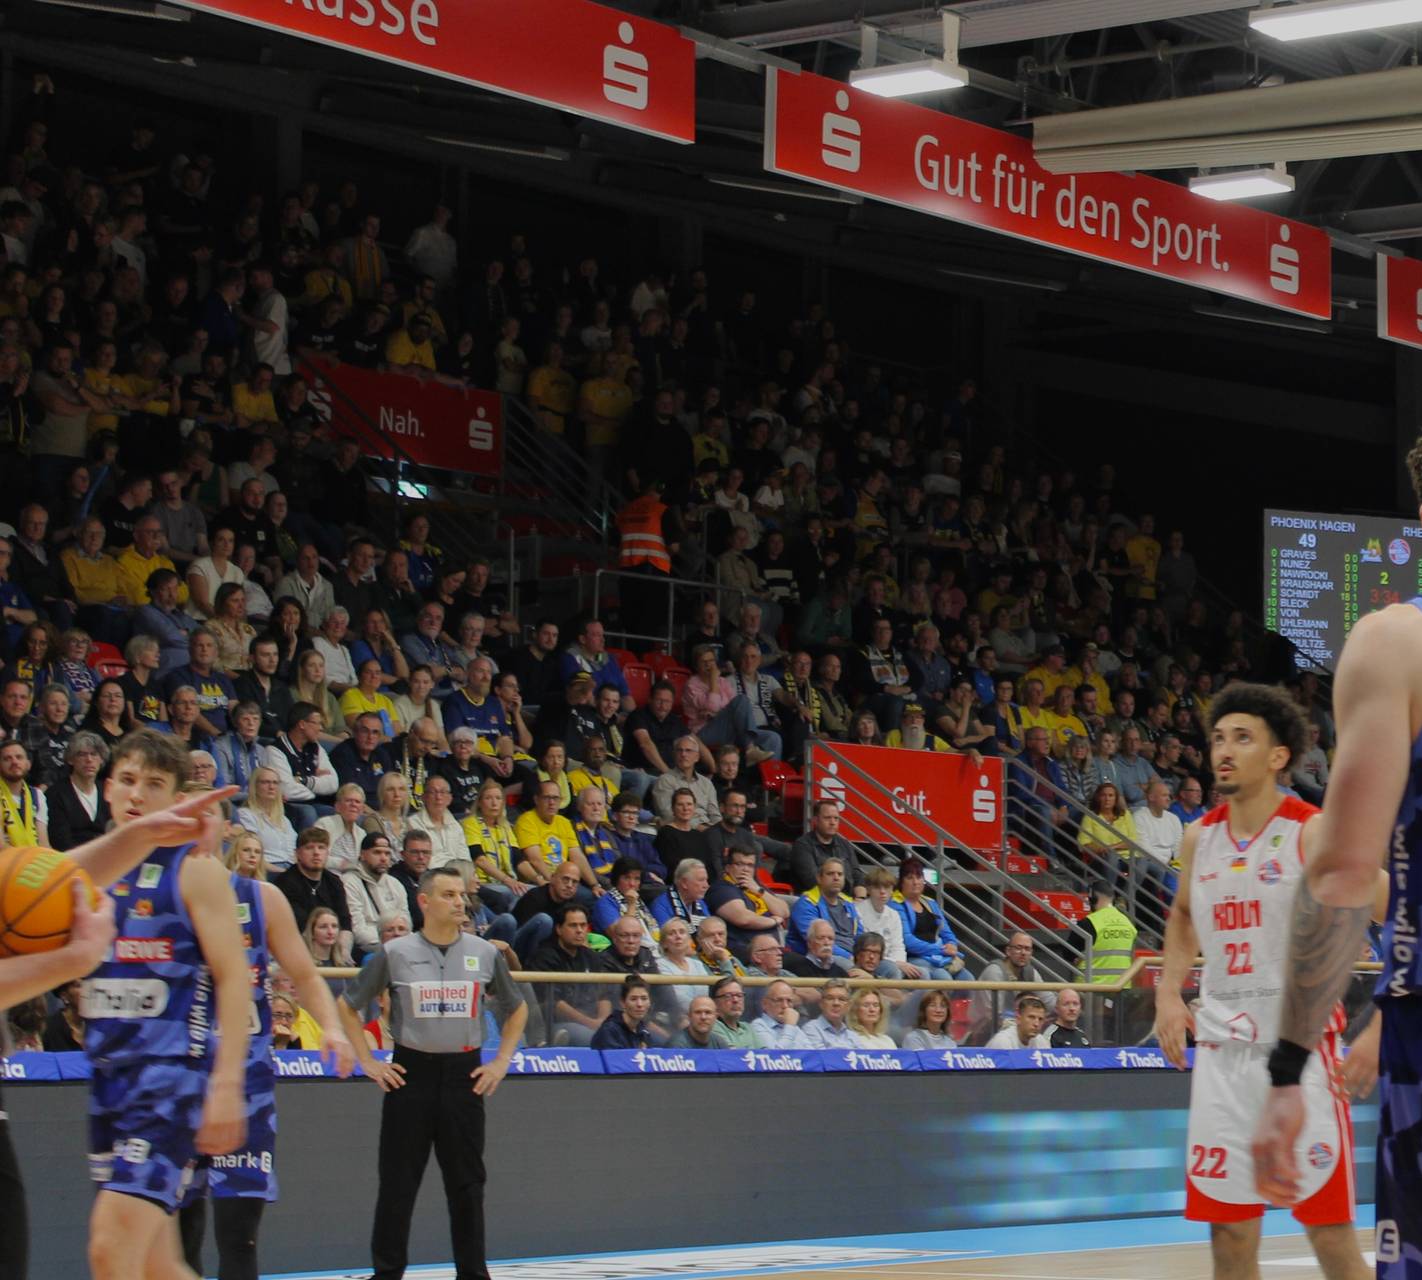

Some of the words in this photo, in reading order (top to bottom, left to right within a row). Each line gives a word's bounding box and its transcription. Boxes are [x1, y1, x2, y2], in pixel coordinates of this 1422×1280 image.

[914, 135, 982, 203] Gut
[992, 153, 1045, 218] für
[1055, 176, 1120, 241] den
[1131, 198, 1230, 272] Sport.
[380, 406, 425, 437] Nah.
[1271, 516, 1317, 530] PHOENIX
[1320, 521, 1355, 532] HAGEN
[1299, 534, 1316, 548] 49
[1280, 550, 1317, 560] GRAVES
[1280, 570, 1328, 580] NAWROCKI
[1380, 572, 1389, 585] 2
[1280, 579, 1334, 590] KRAUSHAAR
[1280, 589, 1320, 599] SCHMIDT
[1280, 599, 1309, 608] BLECK
[1280, 608, 1300, 617] VON
[1280, 618, 1328, 629] UHLEMANN
[1280, 628, 1320, 639] CARROLL
[891, 787, 931, 816] Gut.
[1213, 896, 1262, 931] KÖLN
[1392, 897, 1418, 962] wilo
[1224, 942, 1255, 976] 22
[419, 985, 467, 1001] junited
[420, 1003, 466, 1013] AUTOGLAS
[528, 1054, 579, 1073] Thalia
[648, 1054, 696, 1072] Thalia
[757, 1054, 803, 1071] Thalia
[859, 1053, 902, 1070] Thalia
[952, 1053, 995, 1069] Thalia
[1041, 1052, 1083, 1068] Thalia
[1128, 1052, 1166, 1068] Thalia
[1191, 1145, 1228, 1179] 22
